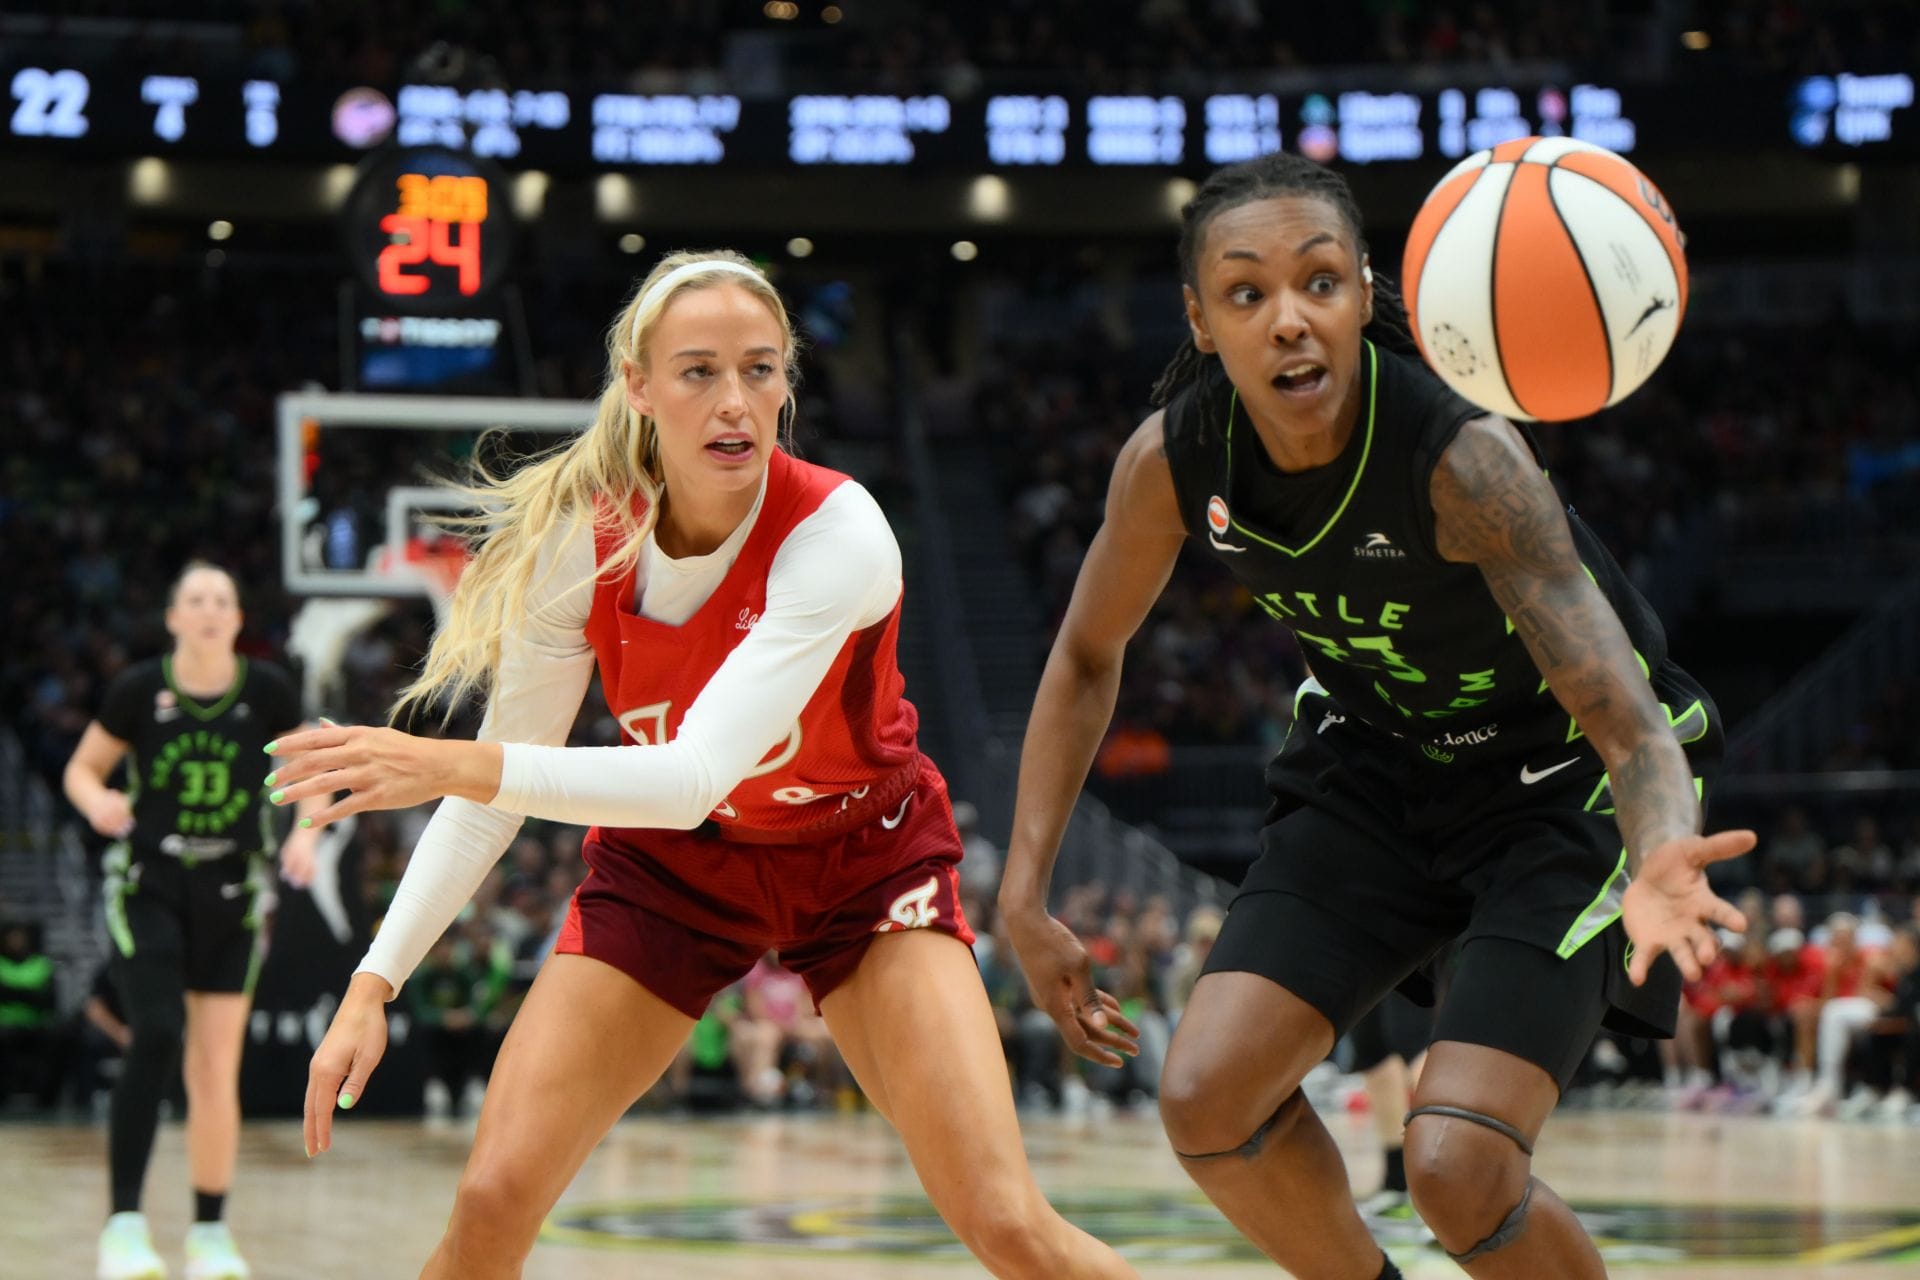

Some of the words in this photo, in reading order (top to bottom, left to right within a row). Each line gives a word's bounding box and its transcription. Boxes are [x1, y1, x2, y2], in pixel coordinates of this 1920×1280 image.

[10, 67, 90, 138] 22
[379, 214, 481, 296] 24
[1353, 546, 1406, 558] SYMETRA
[735, 606, 760, 630] Lil
[1253, 591, 1411, 630] ATTLE
[179, 760, 230, 806] 33
